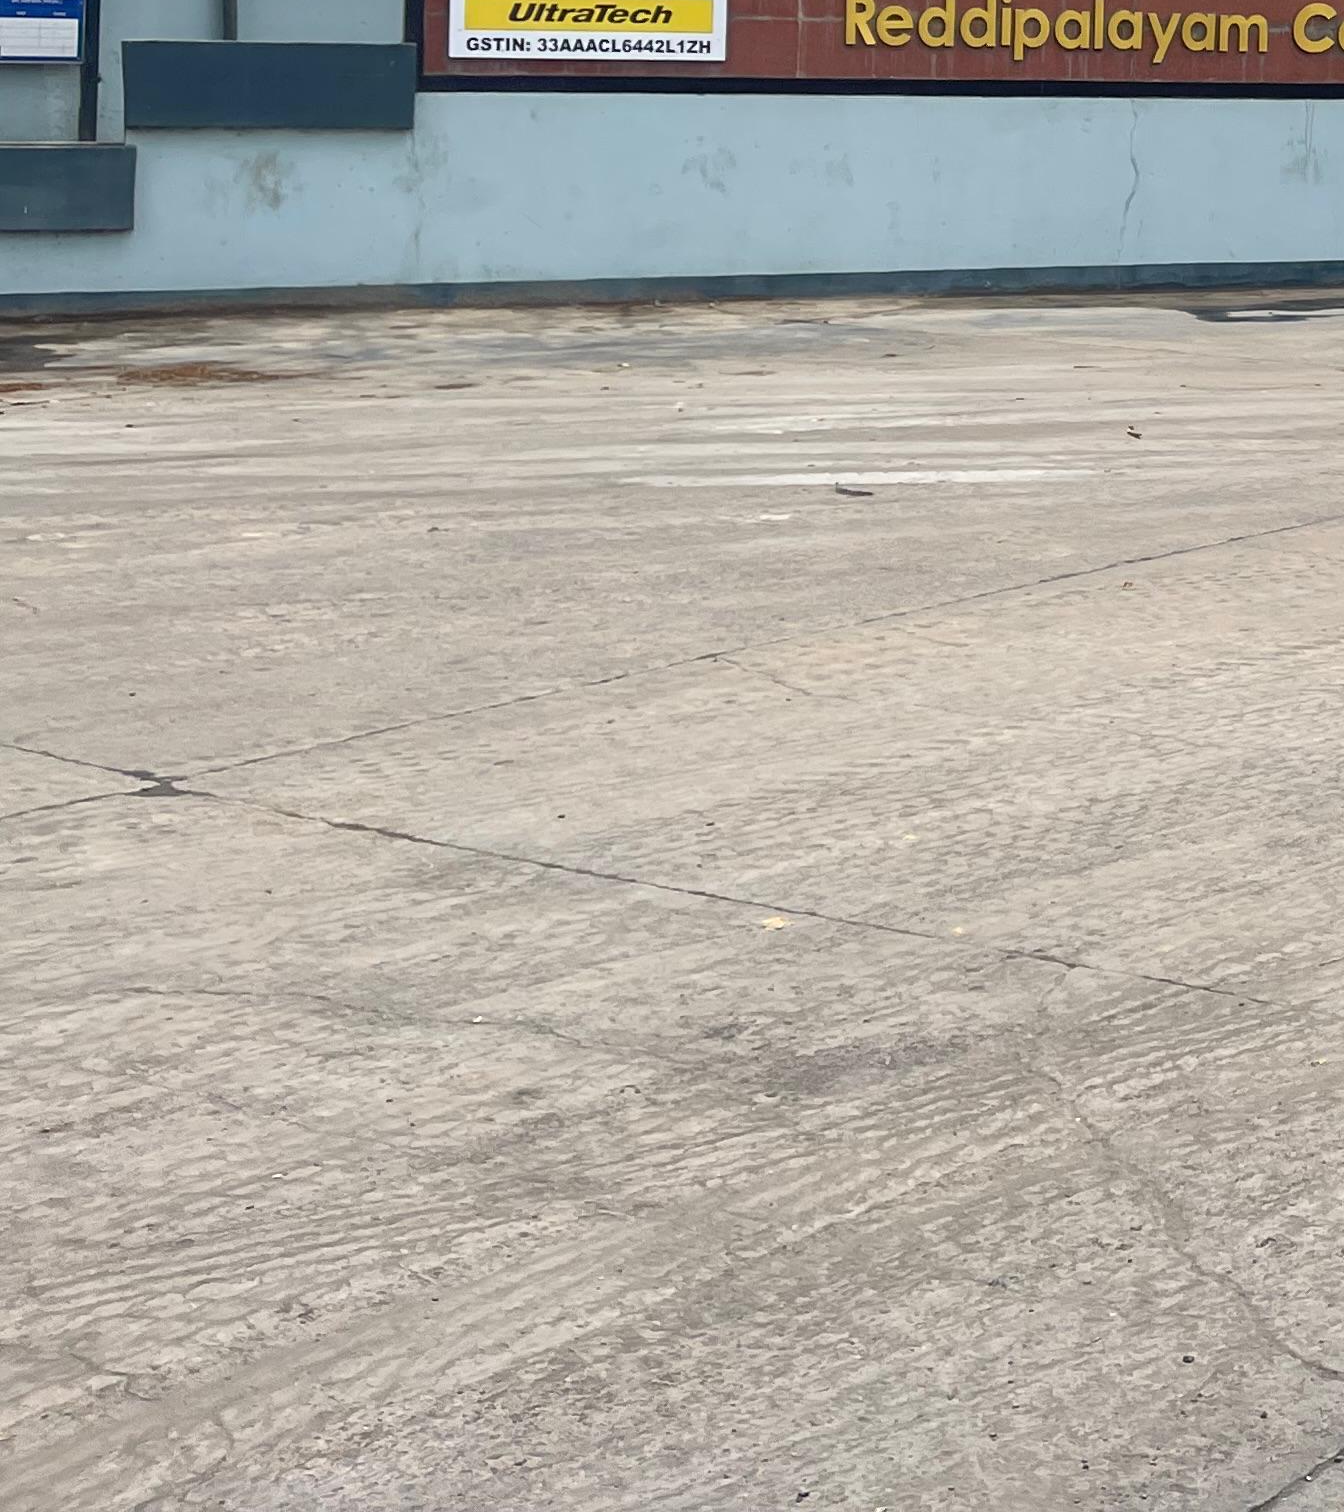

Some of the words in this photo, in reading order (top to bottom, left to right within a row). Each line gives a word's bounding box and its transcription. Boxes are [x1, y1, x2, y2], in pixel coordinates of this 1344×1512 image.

[507, 1, 674, 26] UltraTech
[465, 37, 531, 52] GSTIN:
[537, 38, 712, 54] 33AAACL6442L1ZH
